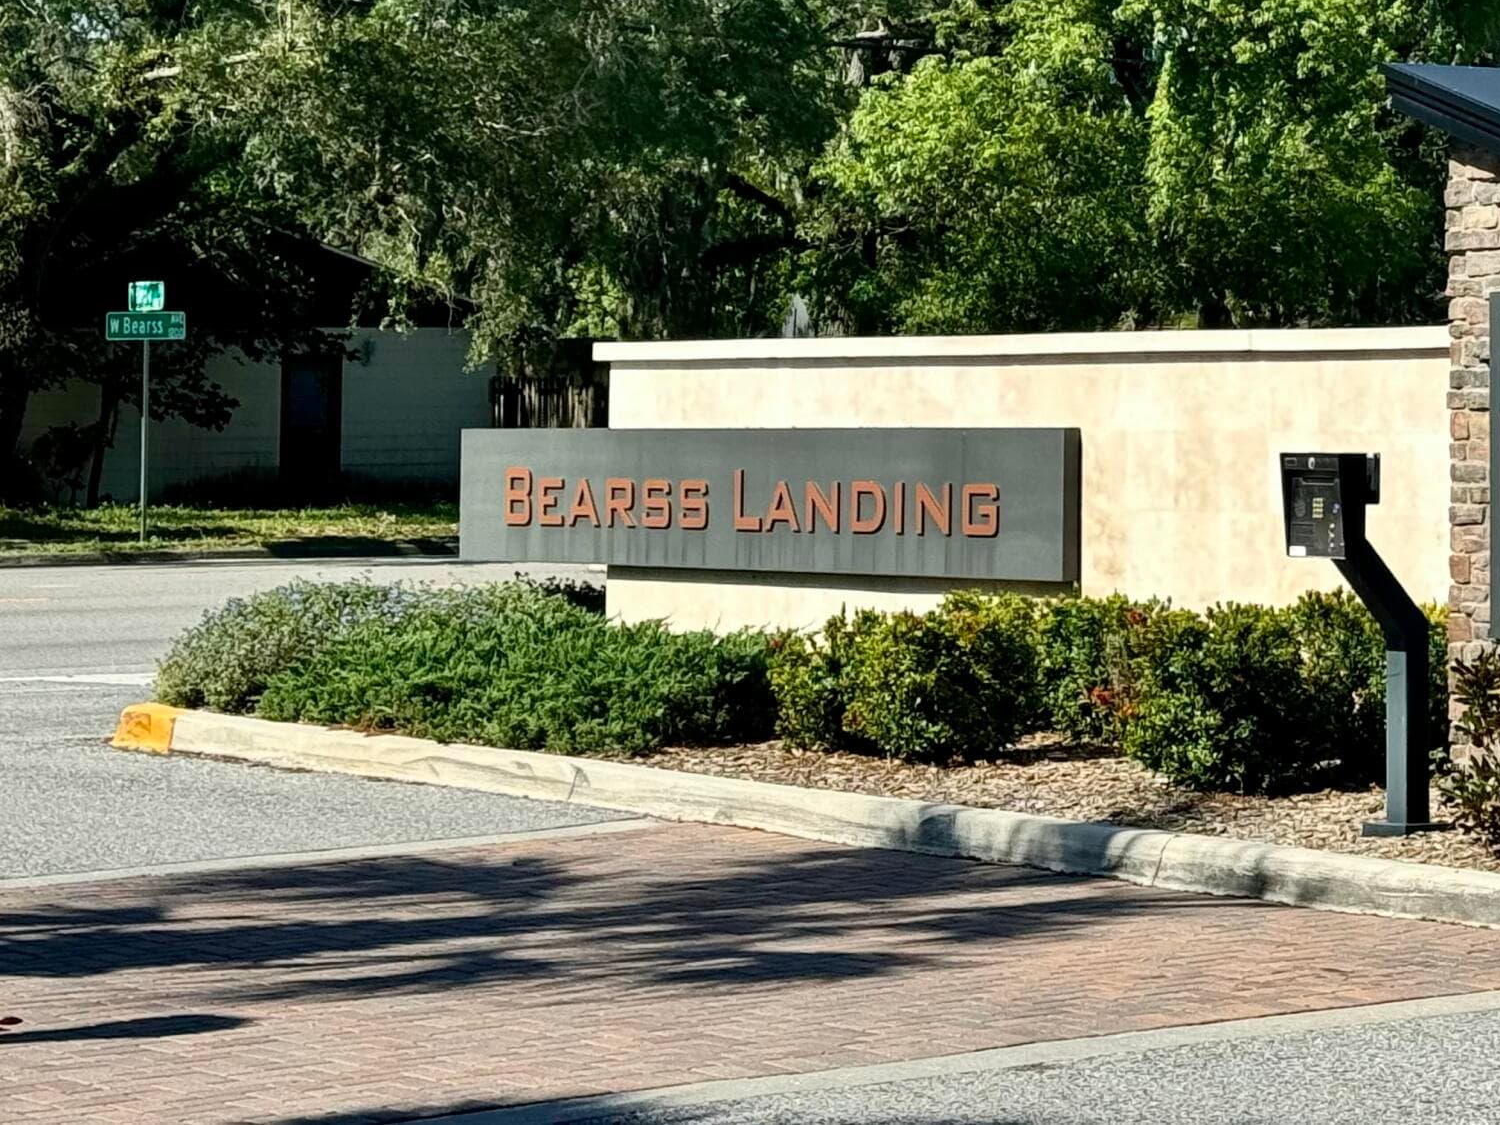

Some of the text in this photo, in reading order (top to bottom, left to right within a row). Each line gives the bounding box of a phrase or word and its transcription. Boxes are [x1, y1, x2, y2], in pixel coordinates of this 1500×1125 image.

[110, 318, 119, 333] W
[123, 317, 163, 334] Bearss
[504, 467, 1000, 538] BEARSS LANDING
